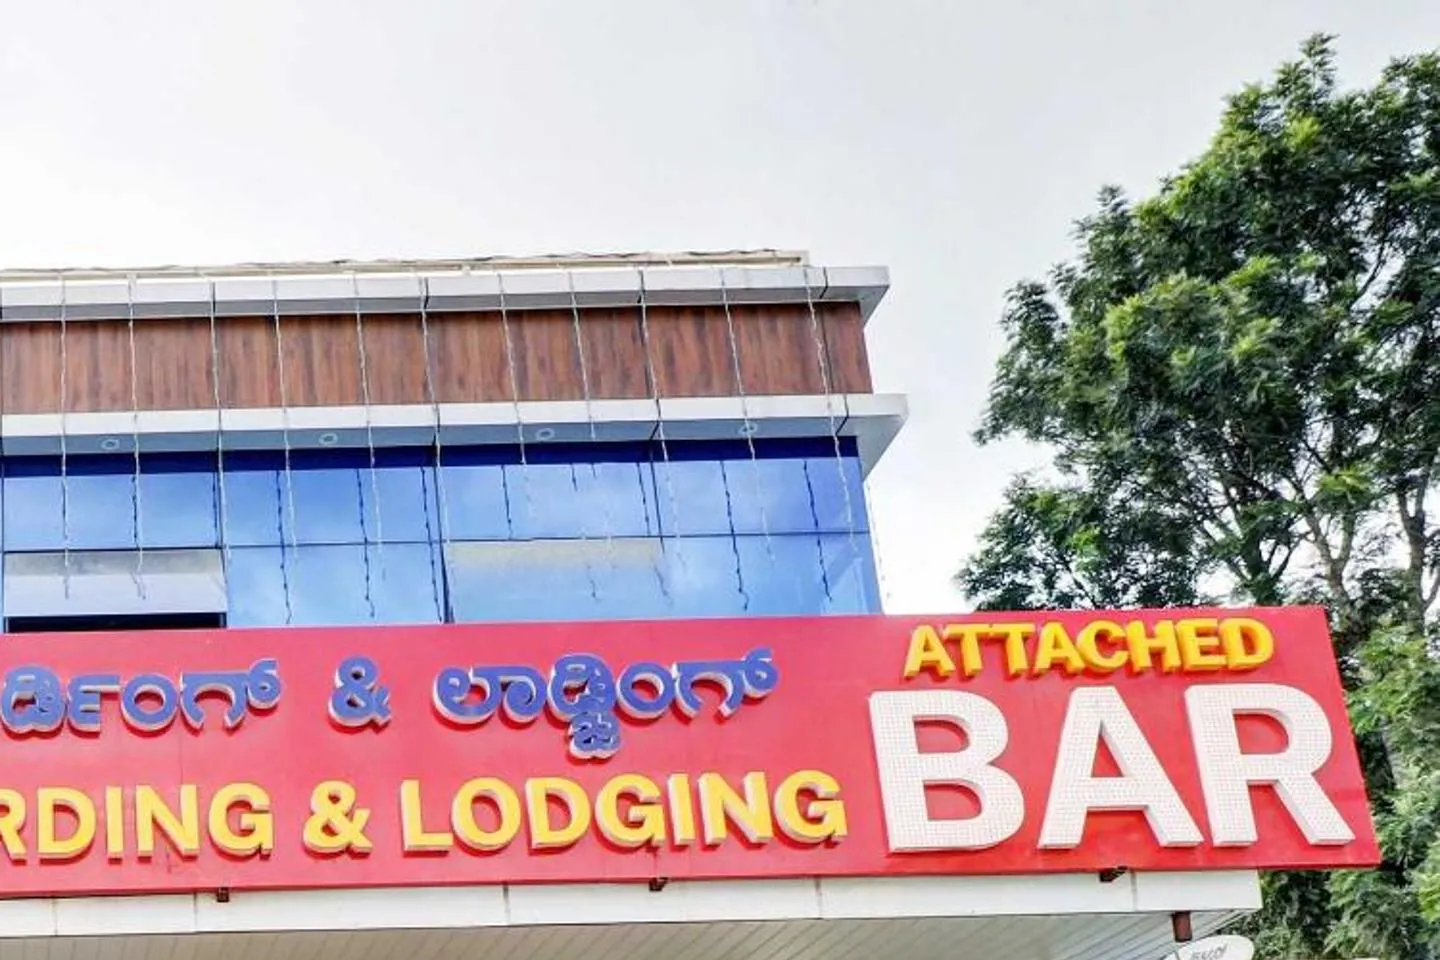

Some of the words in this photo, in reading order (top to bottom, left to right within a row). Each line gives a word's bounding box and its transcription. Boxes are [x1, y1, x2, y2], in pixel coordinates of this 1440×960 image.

[904, 617, 1274, 679] ATTACHED
[327, 655, 391, 728] &
[868, 682, 1356, 853] BAR
[302, 779, 374, 855] &
[400, 768, 849, 853] LODGING
